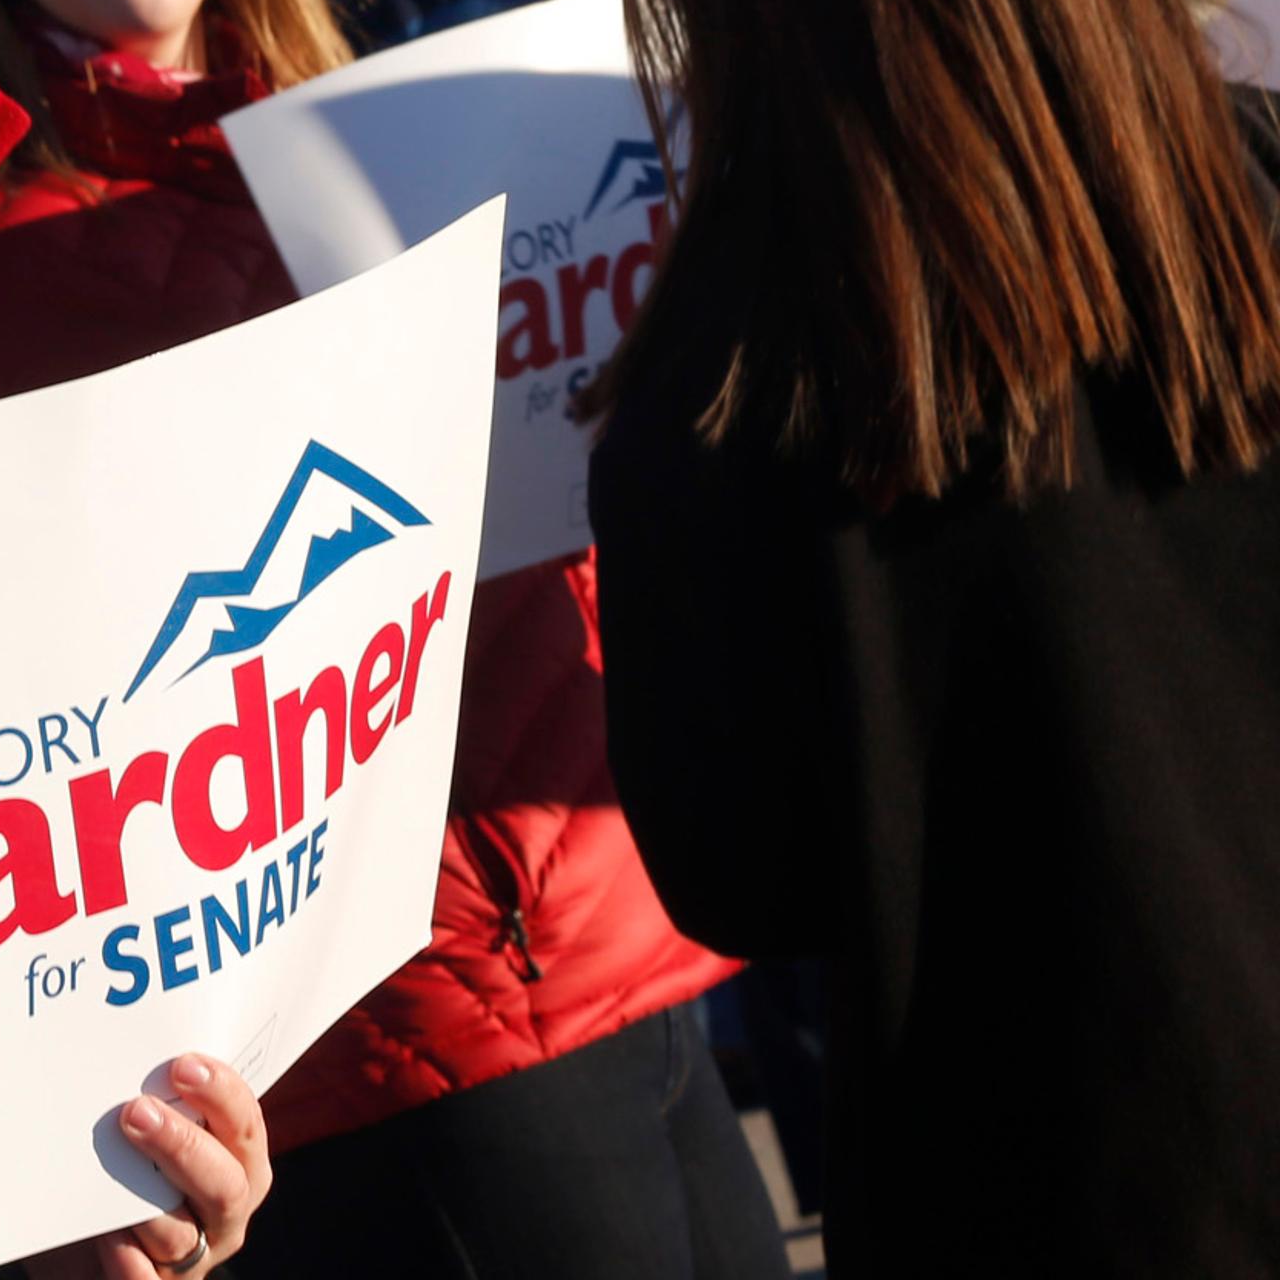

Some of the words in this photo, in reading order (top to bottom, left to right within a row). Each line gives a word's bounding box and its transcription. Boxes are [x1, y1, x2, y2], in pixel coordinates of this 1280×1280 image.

[501, 216, 576, 278] ORY
[23, 954, 86, 1016] for
[101, 818, 330, 1008] SENATE
